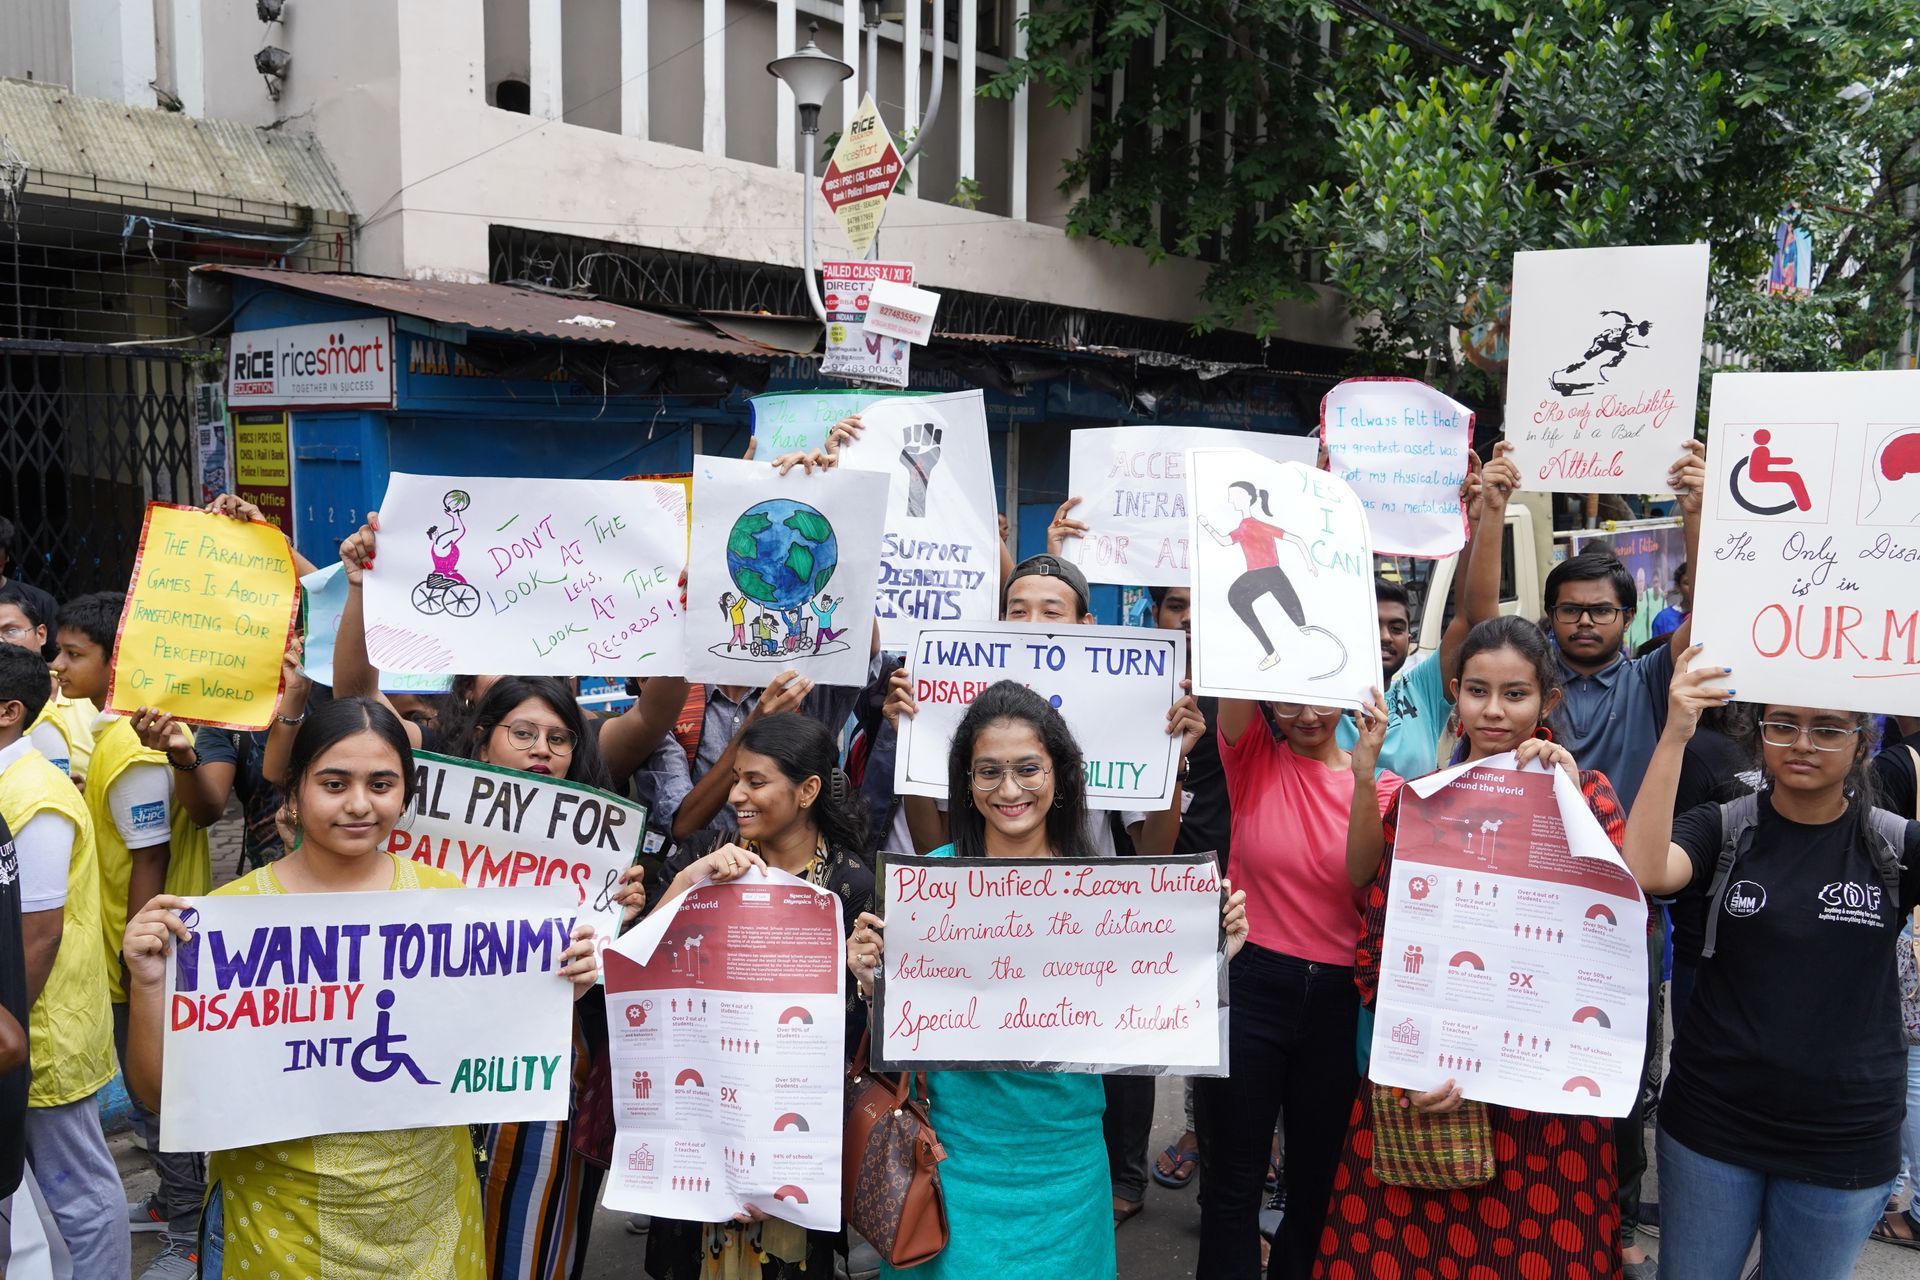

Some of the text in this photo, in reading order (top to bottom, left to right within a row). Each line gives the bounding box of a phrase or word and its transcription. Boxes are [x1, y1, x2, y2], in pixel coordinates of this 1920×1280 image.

[843, 144, 878, 161] ricesmart
[842, 175, 853, 186] PSC
[848, 186, 863, 198] Police
[865, 180, 890, 193] Insurance
[823, 265, 851, 278] FAILED
[853, 266, 880, 280] CLASS
[882, 267, 889, 280] X
[826, 281, 865, 292] DIRECT
[282, 334, 384, 376] ricesmart
[409, 340, 450, 376] MAA
[233, 382, 274, 394] EDUCATION
[292, 380, 375, 393] TOGETHER IN SUCCESS
[1336, 406, 1459, 429] I always felt that
[1533, 399, 1565, 425] The
[1595, 388, 1679, 430] Disability
[257, 432, 269, 444] PSC
[271, 432, 284, 444] CGL
[771, 424, 808, 449] have
[1328, 440, 1458, 457] my greatest asset was
[1526, 429, 1537, 441] in
[1540, 427, 1564, 449] life
[1572, 429, 1582, 440] is
[1611, 423, 1646, 439] Bad
[257, 449, 268, 460] Rail
[271, 450, 285, 461] Bank
[1108, 451, 1187, 480] ACCE
[1538, 448, 1625, 481] Attitude
[241, 466, 286, 478] Police Insurance
[1293, 467, 1342, 504] YES
[1369, 471, 1387, 485] my
[241, 492, 286, 507] City Office
[1112, 489, 1188, 518] INFRA
[1361, 499, 1375, 510] as
[1381, 501, 1396, 512] my
[1404, 502, 1435, 514] mental
[309, 506, 356, 524] 1 2 3
[1319, 507, 1336, 535] I
[164, 531, 289, 574] THE PARALYMPIC
[488, 514, 556, 580] DON'T
[881, 533, 972, 563] SUPPORT
[1076, 534, 1131, 566] FOR
[1713, 530, 1920, 586] The Only Disa
[487, 514, 627, 617] LOOK AT THE
[877, 560, 986, 590] DISABILITY
[147, 568, 191, 593] GAMES
[226, 580, 281, 607] ABOUT
[1791, 577, 1860, 598] is in
[132, 599, 271, 640] TRANSFORMING OUR
[532, 566, 669, 658] LOOK AT THE
[1751, 603, 1868, 661] OUR
[153, 636, 247, 670] PERCEPTION
[922, 640, 1167, 677] I WANT TO TURN
[130, 668, 255, 702] OF THE WORLD
[1473, 771, 1506, 784] Unified
[1479, 782, 1495, 793] the
[1496, 784, 1525, 797] World
[133, 810, 164, 823] NHPC
[464, 775, 540, 834] PAY
[546, 791, 627, 852] FOR
[592, 868, 619, 914] &
[892, 867, 958, 909] Play
[967, 868, 1058, 898] Unified
[1149, 865, 1221, 894] Unified
[691, 900, 719, 911] World
[1818, 913, 1836, 922] Anything
[1840, 915, 1862, 924] everything
[1824, 906, 1842, 915] Anything
[1045, 911, 1084, 937] the
[1094, 908, 1177, 938] distance
[206, 923, 371, 991] WANT
[378, 922, 426, 981] TO
[426, 919, 515, 978] TURN
[516, 916, 578, 975] MY
[891, 951, 1180, 988] between the average and
[1508, 971, 1534, 989] 9X
[888, 996, 982, 1052] Special
[998, 996, 1104, 1031] education
[720, 1086, 738, 1104] 9X
